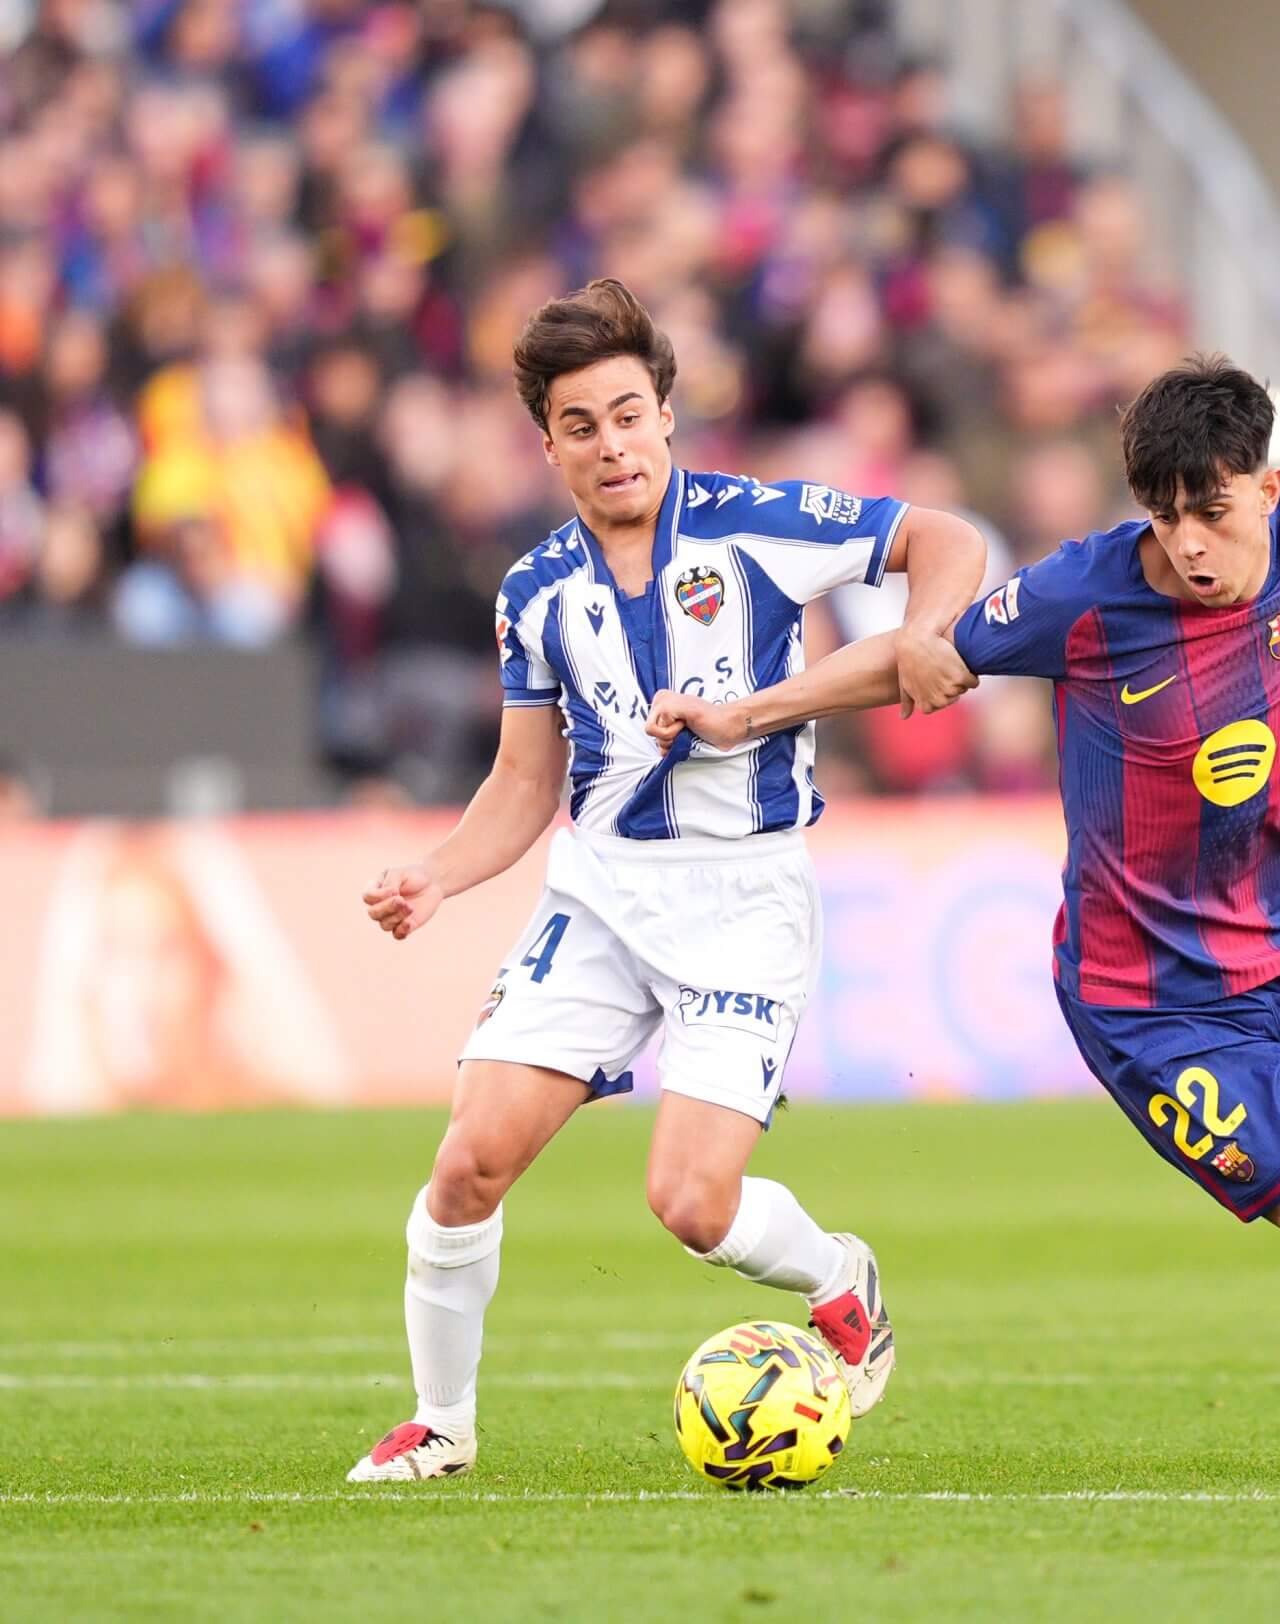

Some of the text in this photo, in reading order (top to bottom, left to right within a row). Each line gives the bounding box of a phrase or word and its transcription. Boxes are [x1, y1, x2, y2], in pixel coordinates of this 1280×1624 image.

[497, 912, 571, 984] 4
[695, 991, 775, 1026] JYSK
[1148, 1066, 1247, 1160] 22
